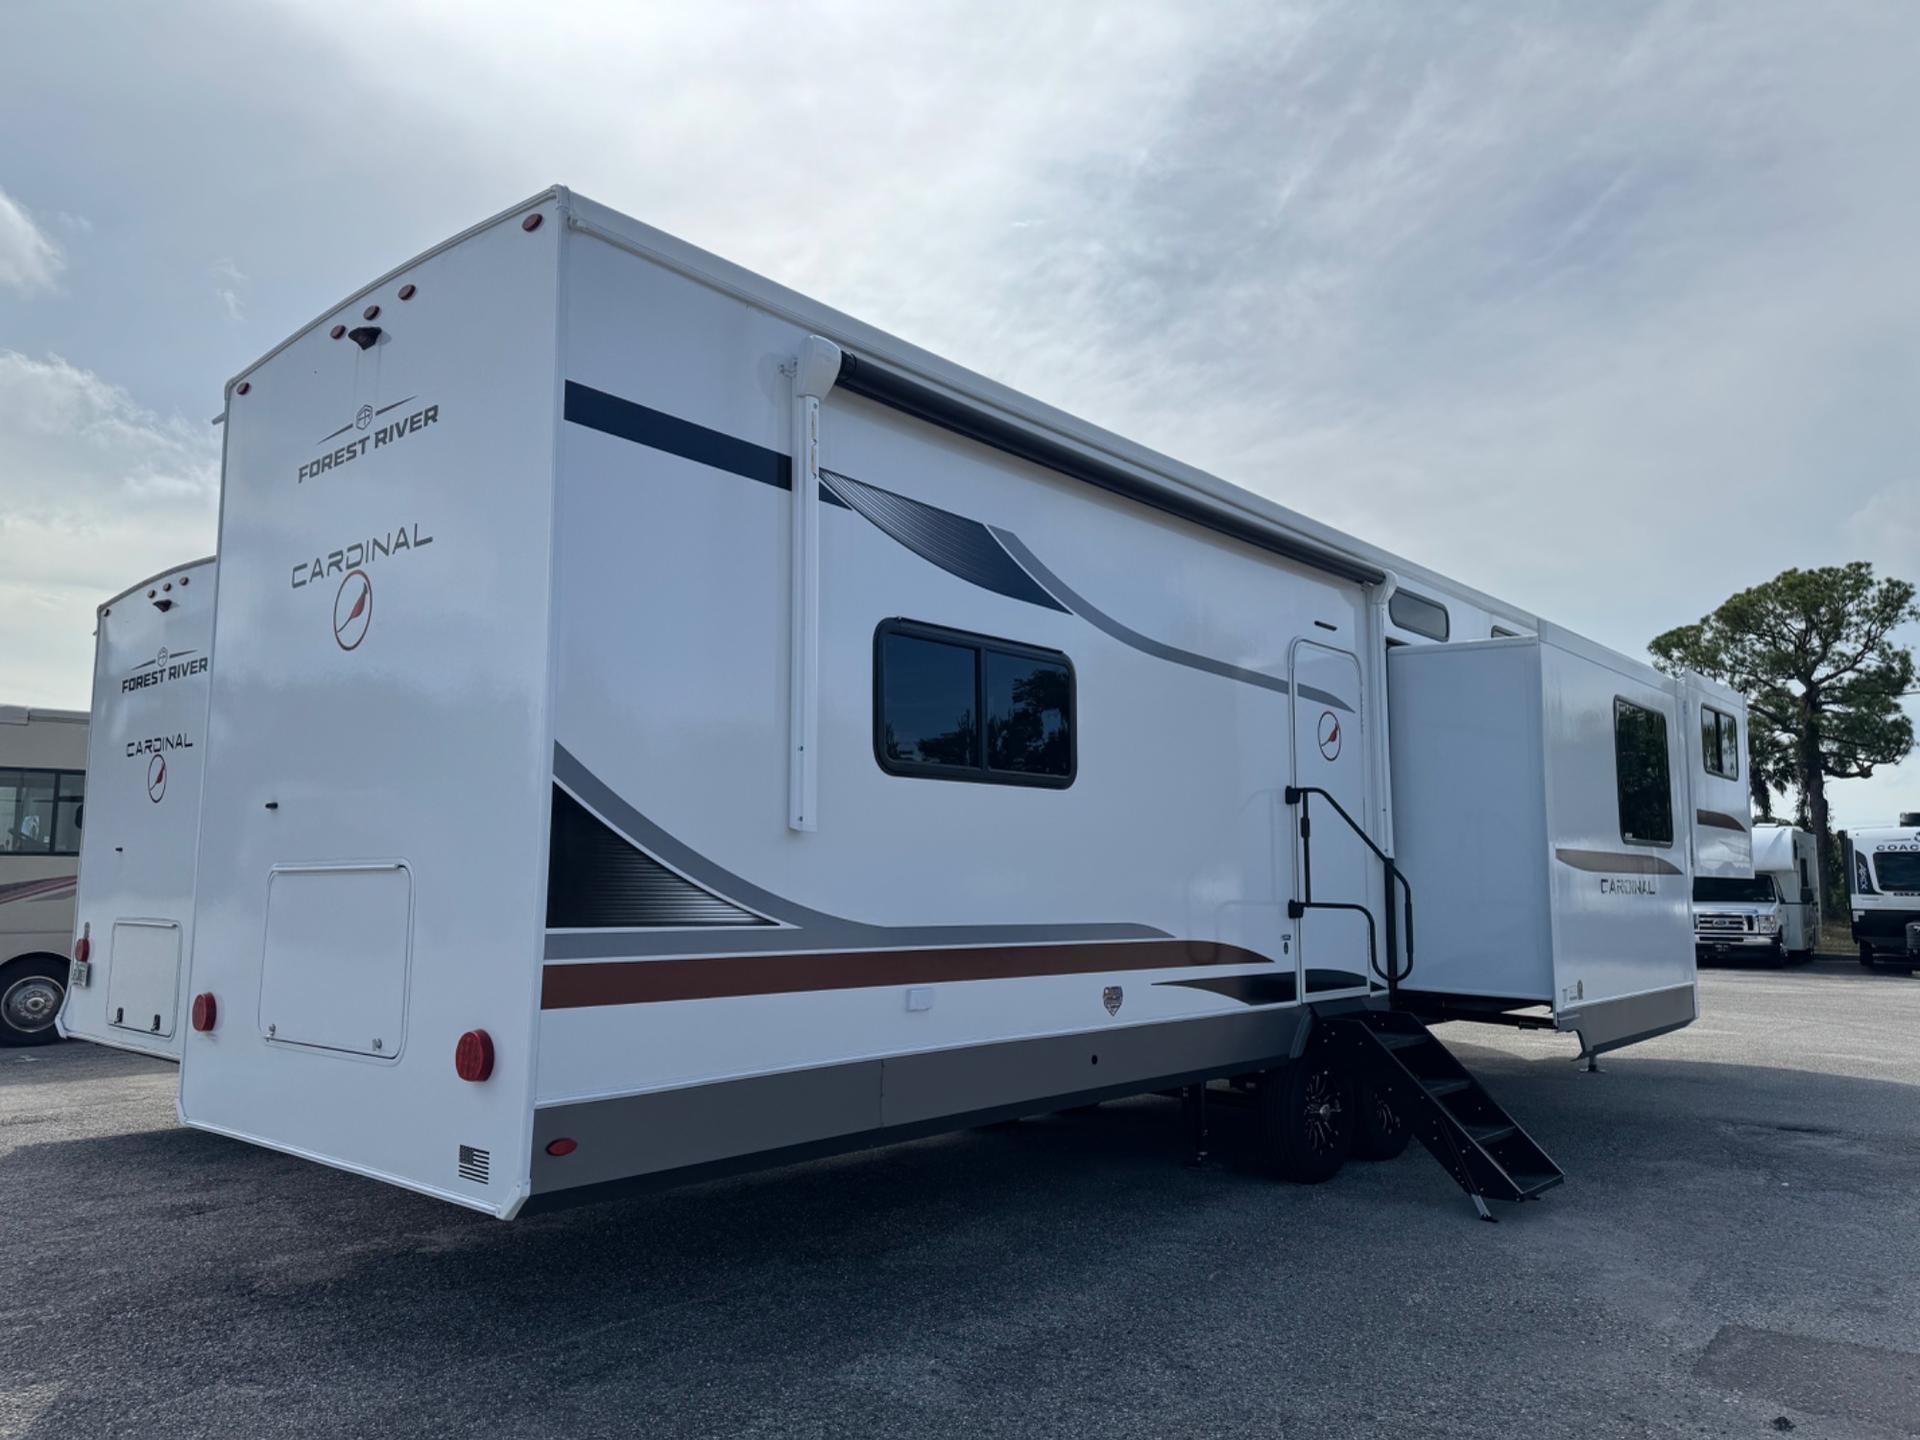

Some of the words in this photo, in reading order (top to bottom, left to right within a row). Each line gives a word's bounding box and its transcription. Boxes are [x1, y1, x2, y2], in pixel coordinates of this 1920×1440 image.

[298, 435, 370, 484] FOREST
[374, 405, 439, 449] RIVER
[291, 523, 433, 588] CARDINAL
[121, 669, 166, 693] FOREST
[168, 657, 208, 680] RIVER
[126, 733, 193, 757] CARDINAL
[1600, 879, 1656, 895] CARDINAL
